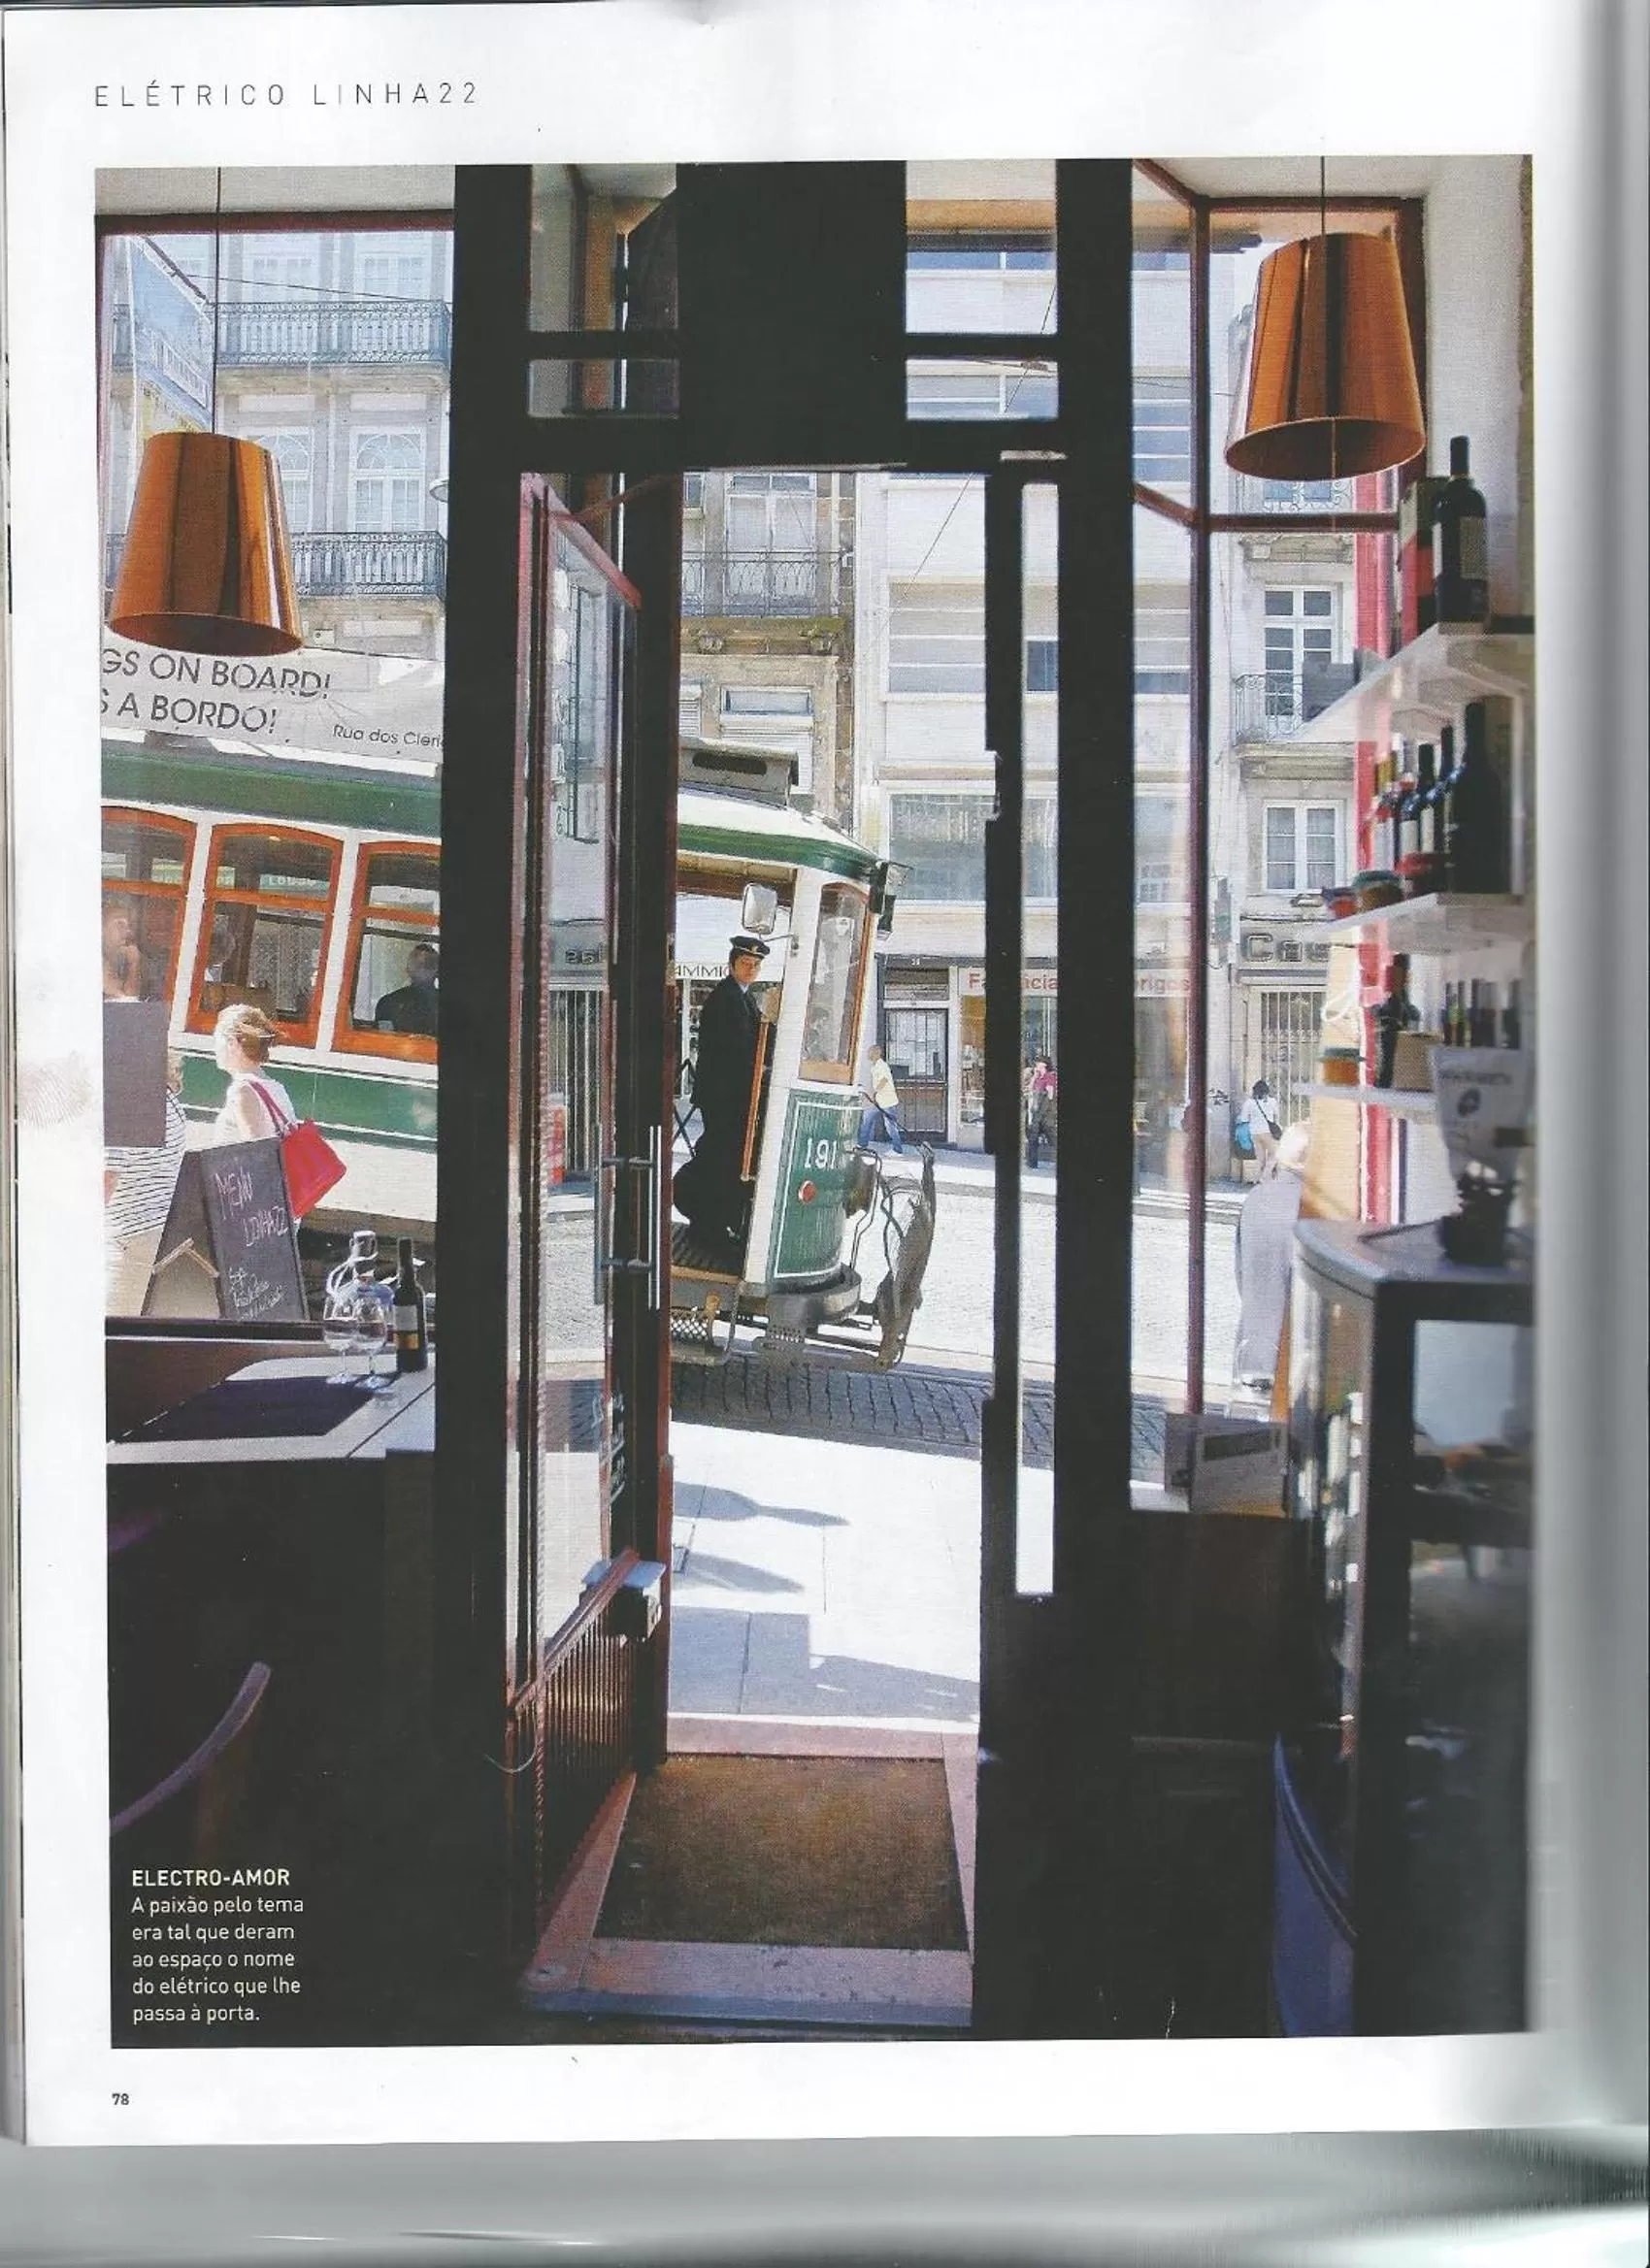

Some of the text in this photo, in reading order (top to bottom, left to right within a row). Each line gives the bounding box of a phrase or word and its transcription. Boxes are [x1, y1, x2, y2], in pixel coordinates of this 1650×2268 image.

[95, 79, 476, 107] ELÉTRICO LINHA22
[149, 653, 201, 684] ON
[212, 660, 330, 699] BOARD!
[116, 692, 140, 718] A
[150, 694, 277, 735] BORDO!
[333, 724, 445, 748] Rua dos Cleri
[132, 1869, 290, 1887] ELECTRO-AMOR
[132, 1895, 304, 1918] A paixão pelo tema
[132, 1923, 294, 1944] era tal que deram
[132, 1953, 295, 1972] ao espaço o nome
[132, 1976, 301, 1998] do elétrico que lhe
[133, 2004, 260, 2025] passa à porta.
[112, 2092, 130, 2106] 78
